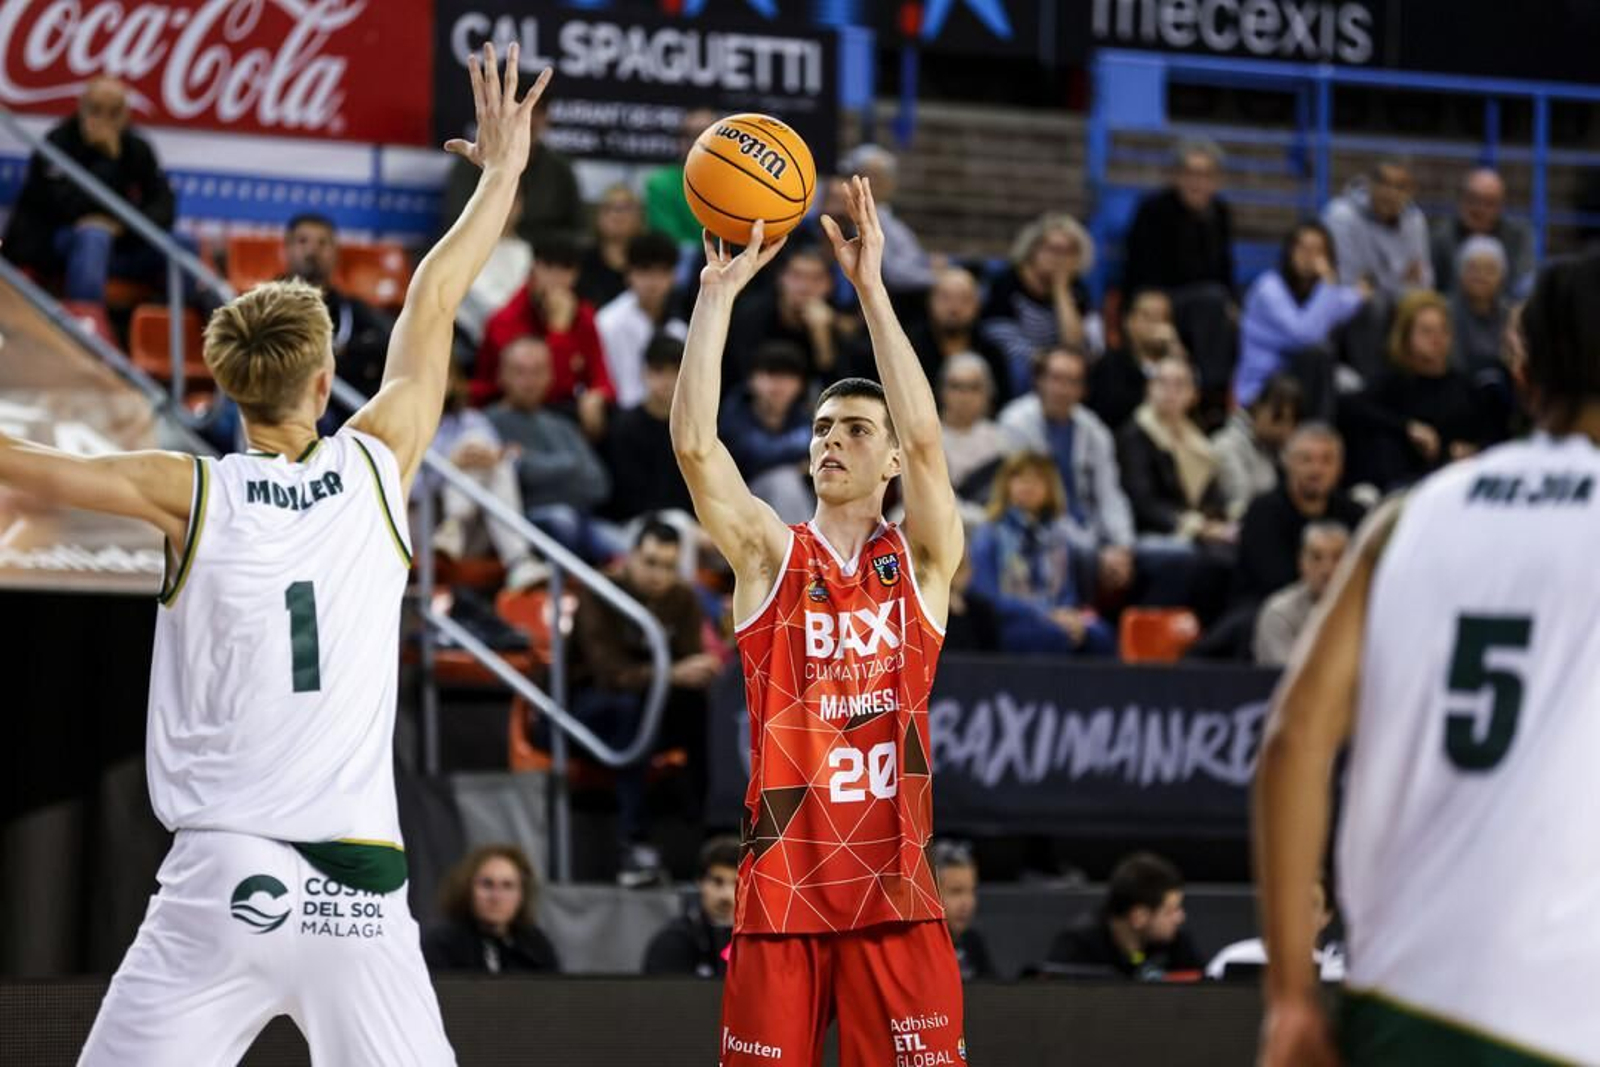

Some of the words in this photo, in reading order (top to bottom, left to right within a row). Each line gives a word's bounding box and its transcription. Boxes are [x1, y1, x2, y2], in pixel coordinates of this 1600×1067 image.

[558, 21, 822, 94] SPAGUETTI
[715, 126, 786, 180] Wilson
[285, 581, 320, 692] 1
[1445, 612, 1534, 774] 5
[829, 742, 897, 803] 20
[303, 902, 345, 917] DEL
[350, 902, 384, 918] SOL
[301, 919, 384, 938] MÁLAGA
[891, 1011, 949, 1032] Adbisio
[728, 1034, 782, 1060] Kouten
[894, 1033, 927, 1053] ETL
[896, 1050, 954, 1067] GLOBAL
